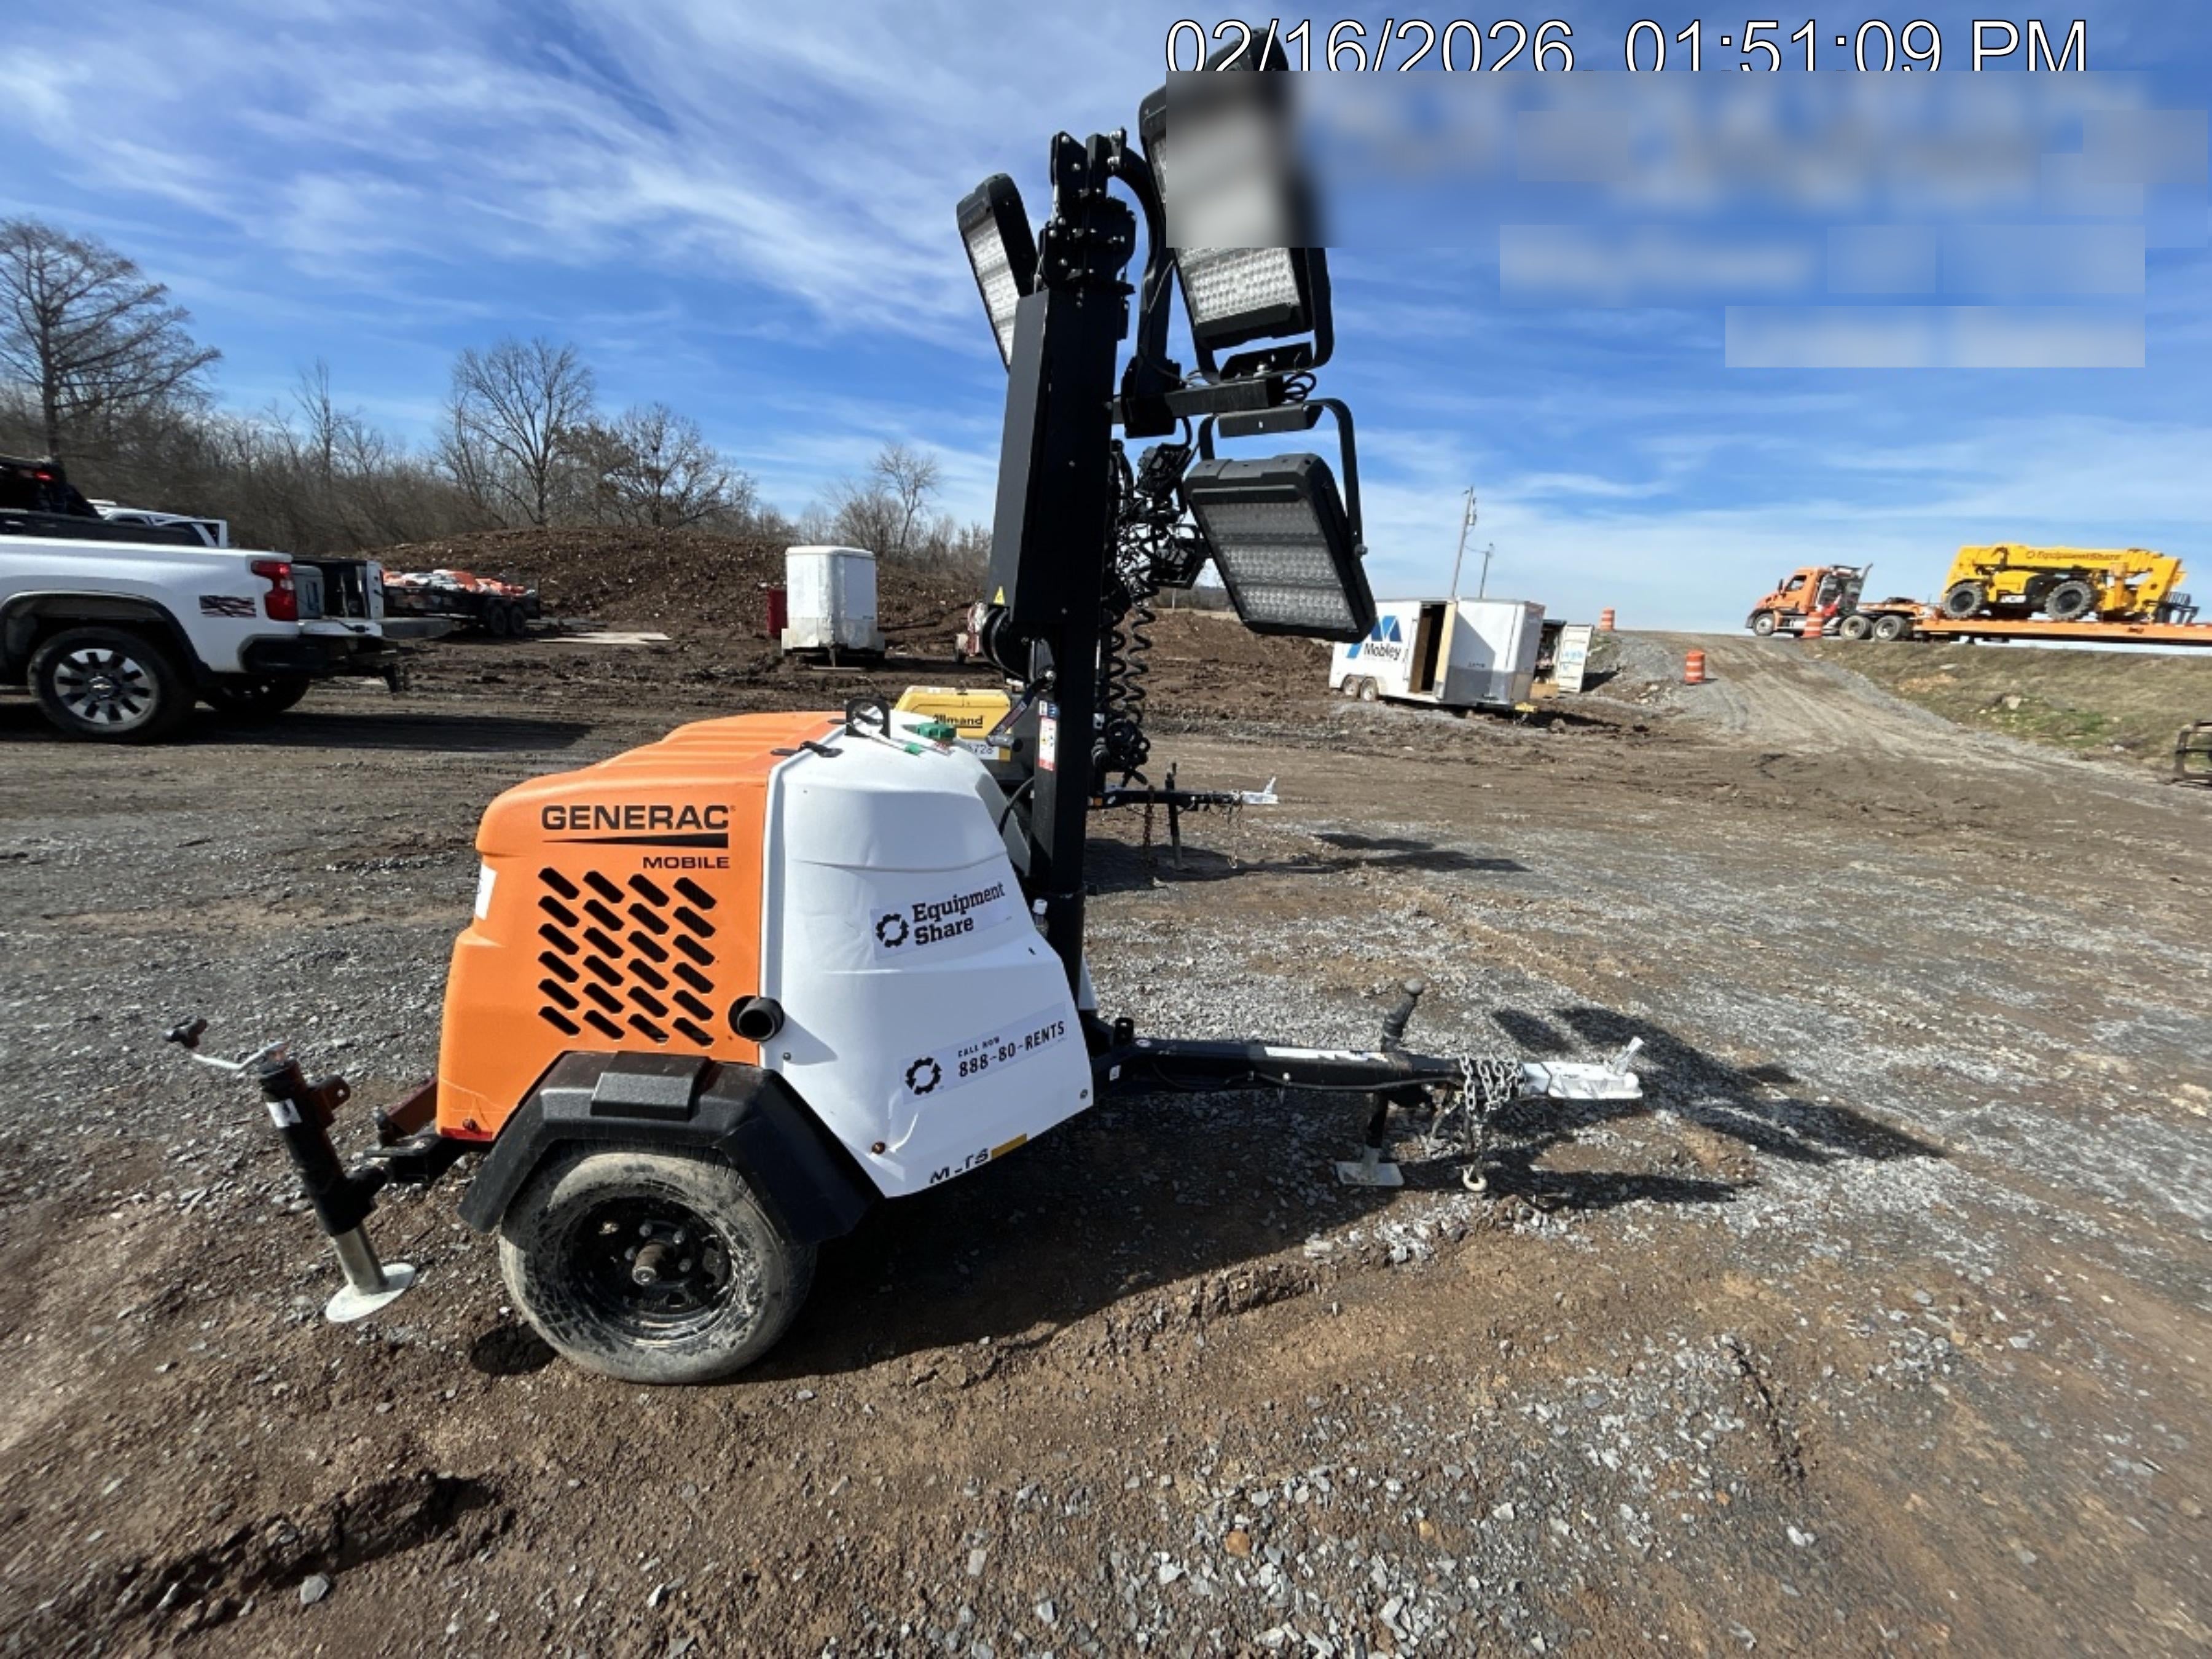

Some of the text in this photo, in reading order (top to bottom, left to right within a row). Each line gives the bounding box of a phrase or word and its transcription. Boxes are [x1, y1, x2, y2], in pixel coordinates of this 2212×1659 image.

[1364, 643, 1401, 661] Mobley
[541, 805, 729, 830] GENERAC
[643, 857, 730, 869] MOBILE
[912, 881, 1005, 923] Equipment
[914, 917, 975, 946] Share
[958, 1036, 1000, 1059] CALL NOW
[959, 1021, 1065, 1078] 888-80-RENTS
